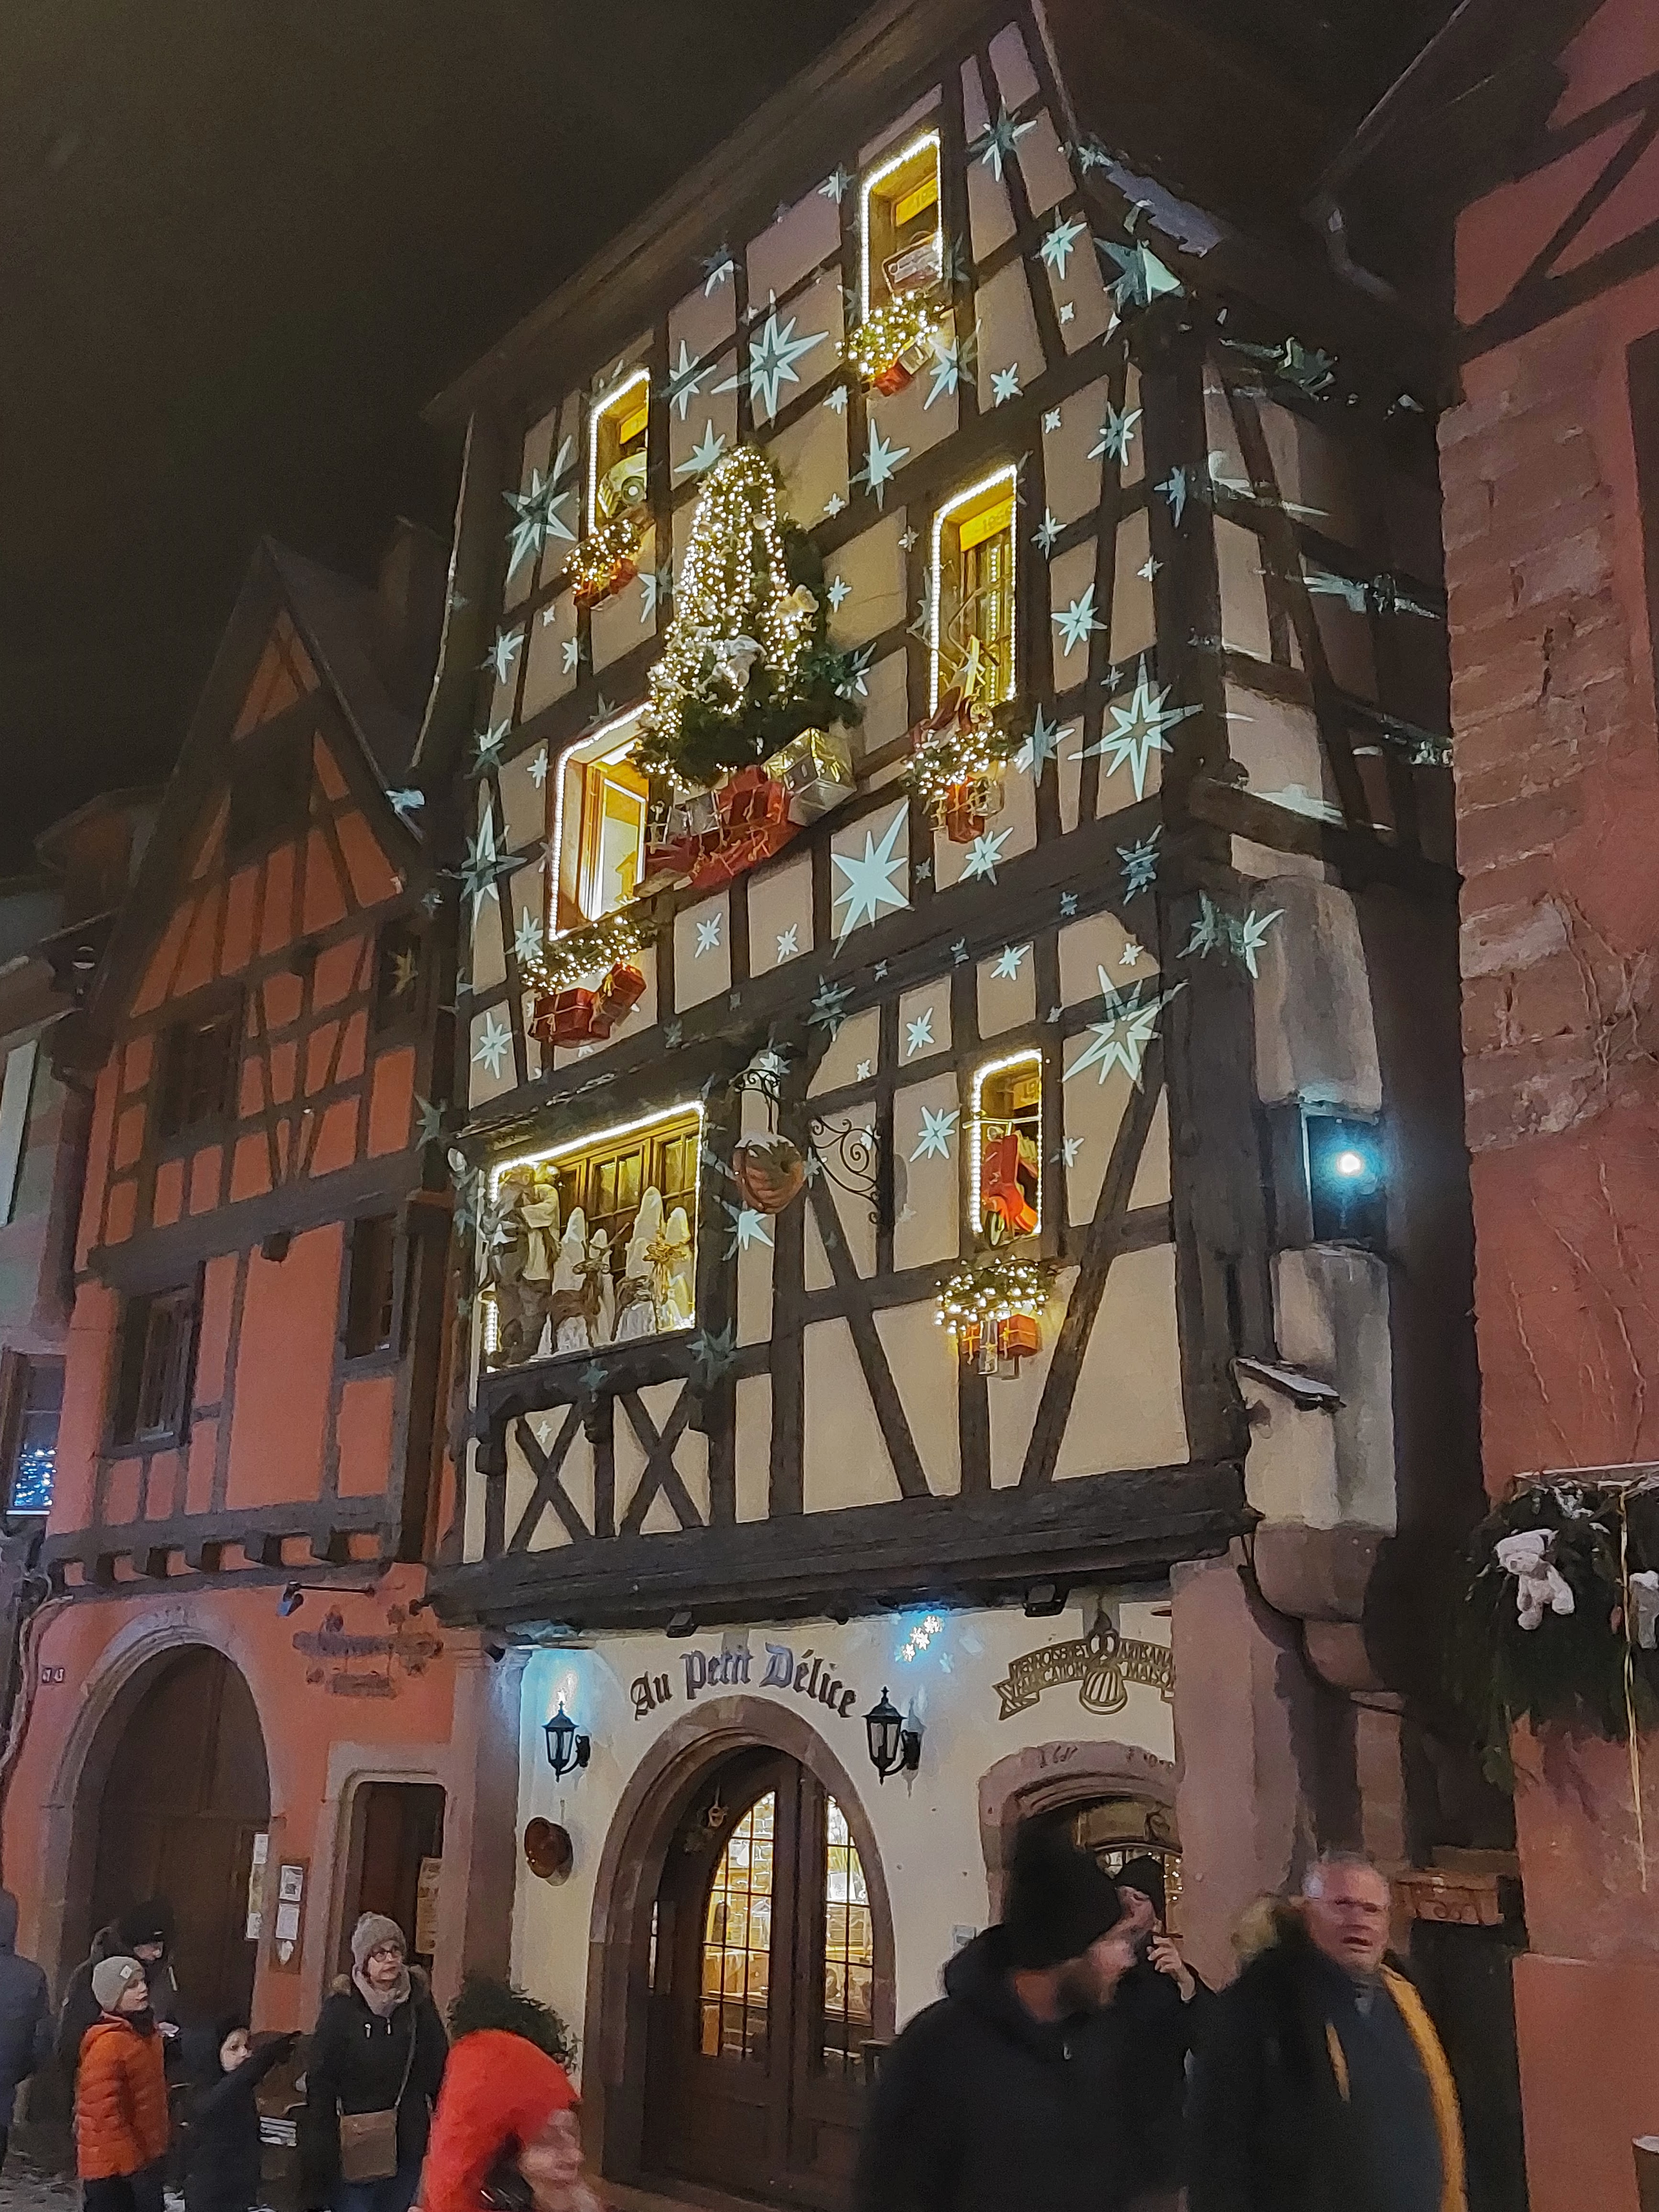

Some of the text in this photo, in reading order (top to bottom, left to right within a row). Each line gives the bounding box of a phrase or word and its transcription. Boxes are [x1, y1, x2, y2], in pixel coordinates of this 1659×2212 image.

[630, 1642, 856, 1721] Au Petit Délice
